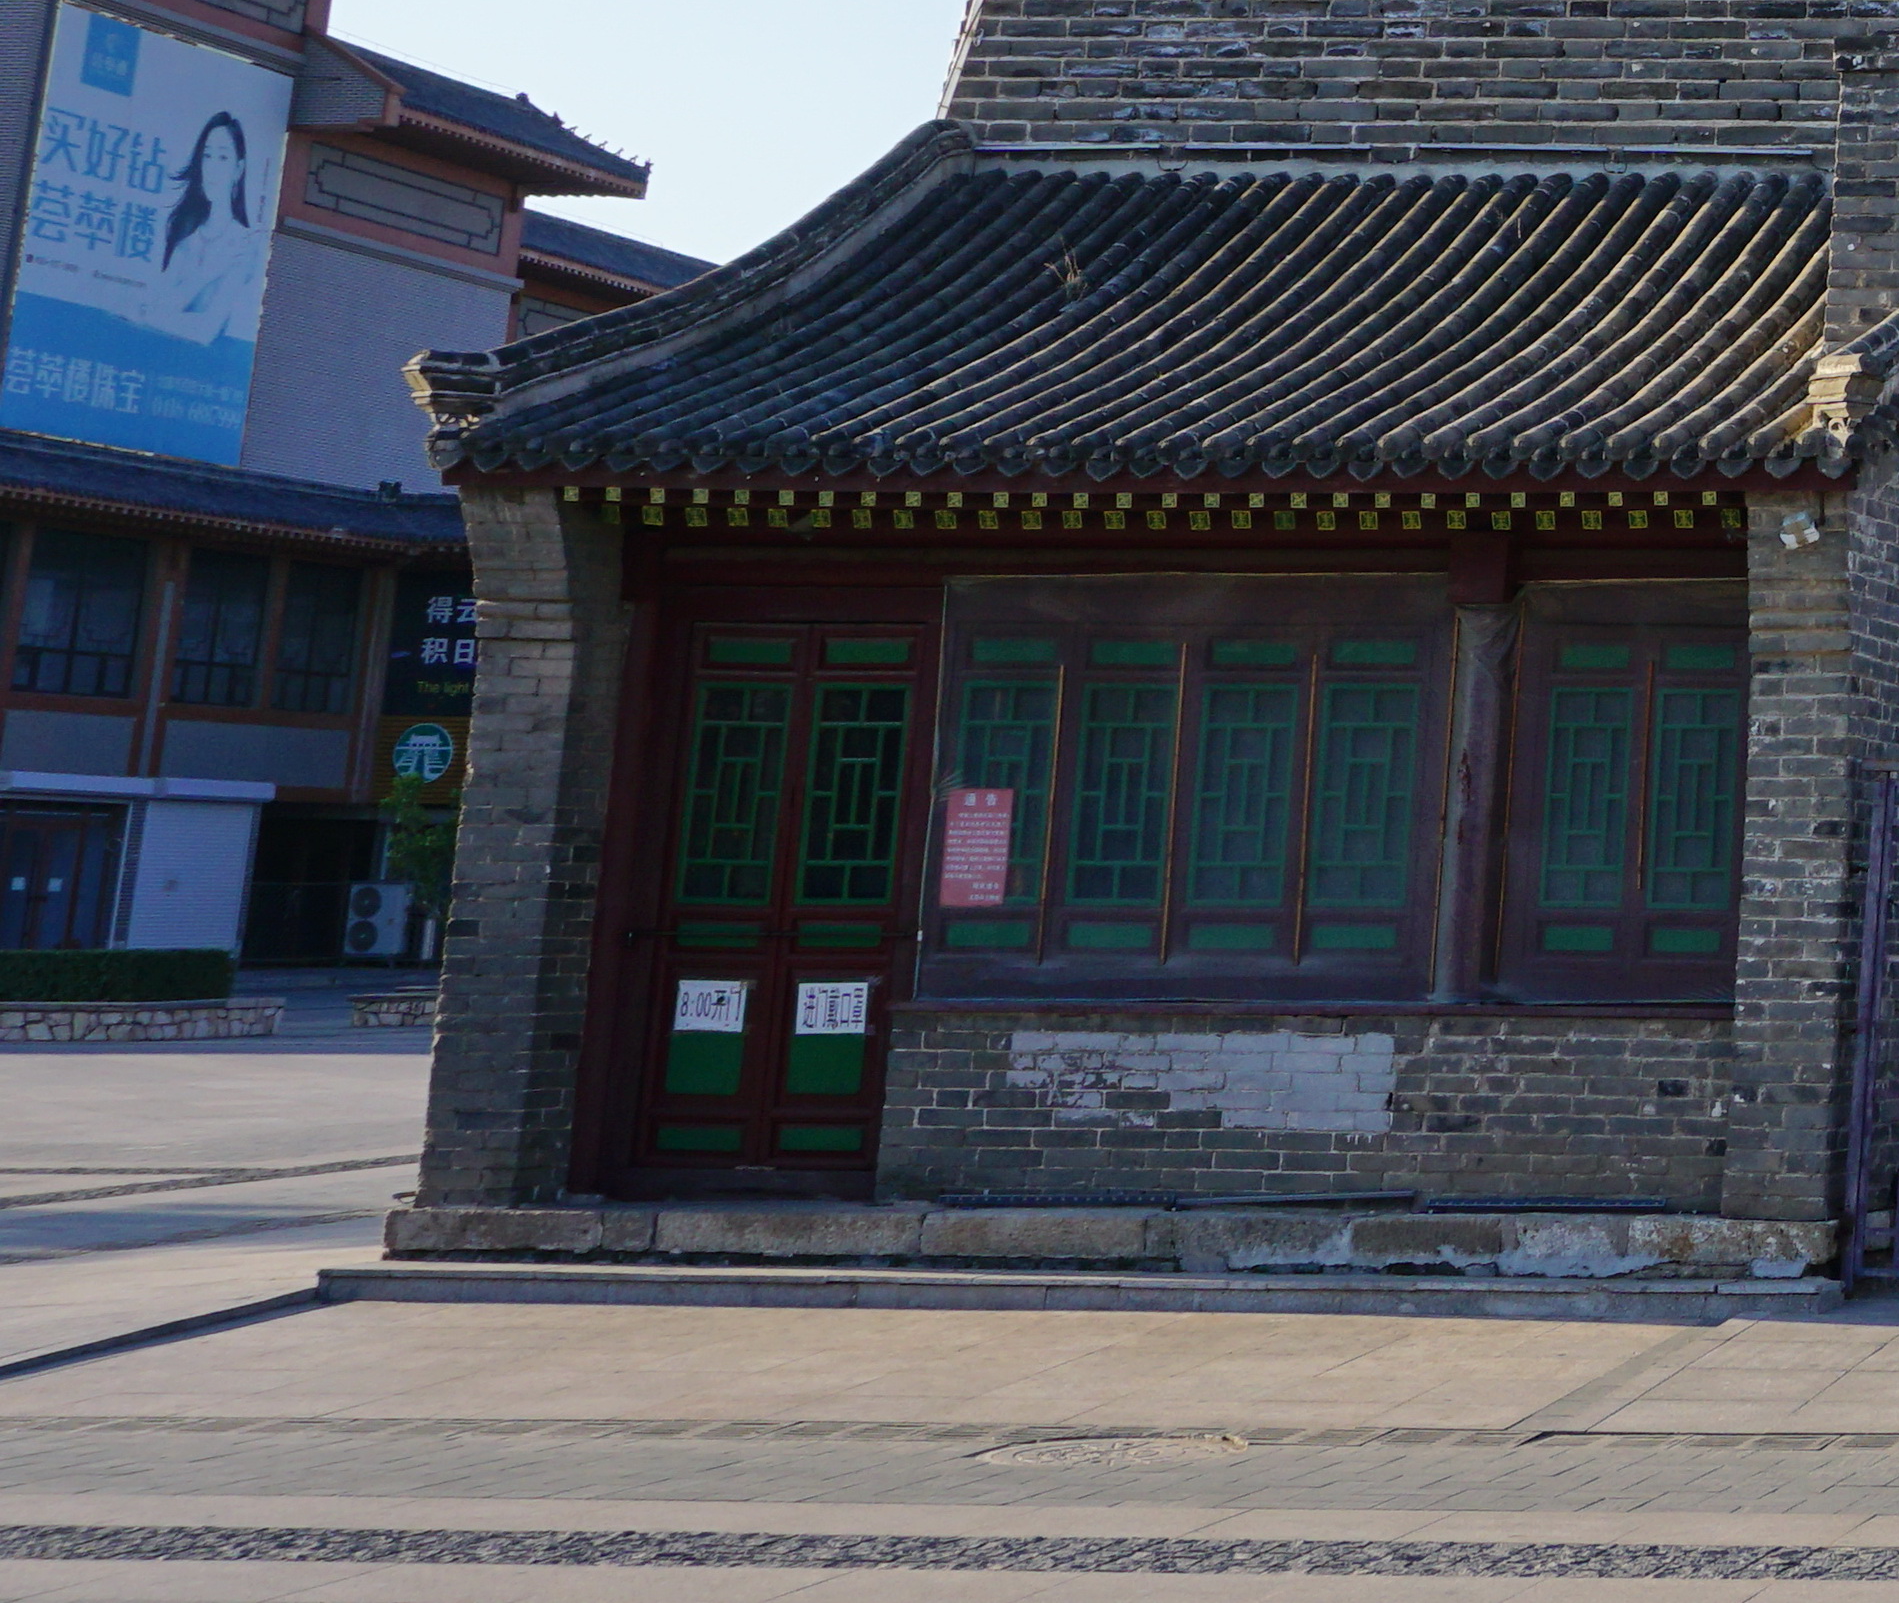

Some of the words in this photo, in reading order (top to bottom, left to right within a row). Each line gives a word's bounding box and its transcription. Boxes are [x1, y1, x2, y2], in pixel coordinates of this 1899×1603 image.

[40, 106, 168, 194] 买好钻
[29, 179, 159, 263] 荟萃楼
[963, 793, 998, 807] 通告
